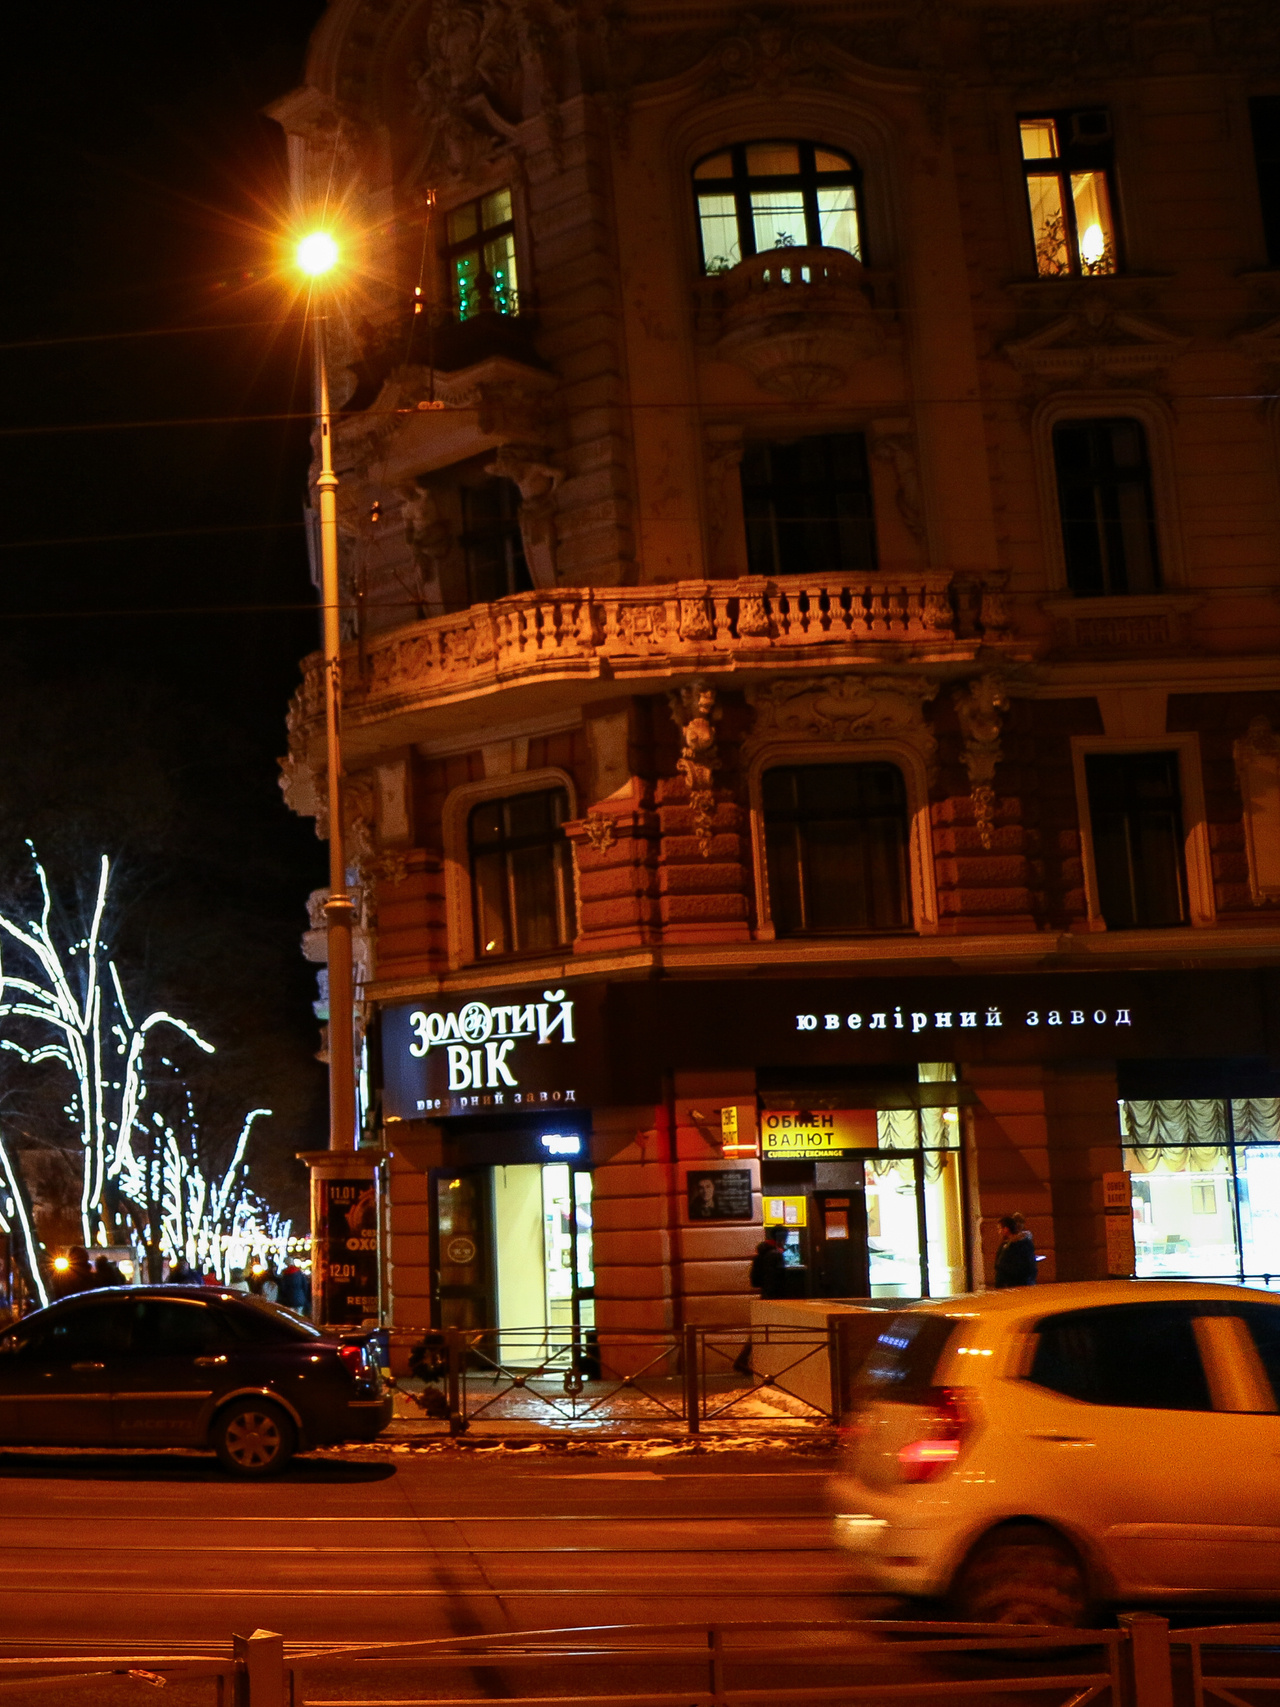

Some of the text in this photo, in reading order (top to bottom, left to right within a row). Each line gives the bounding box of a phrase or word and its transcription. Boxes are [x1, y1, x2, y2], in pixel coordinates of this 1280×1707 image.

[796, 1006, 1132, 1033] ювелірний завод
[513, 1089, 576, 1104] завод
[767, 1114, 834, 1128] ОБМЕН
[768, 1132, 835, 1147] ВАЛЮТ
[330, 1186, 356, 1200] 11.01
[329, 1264, 356, 1277] 12.01
